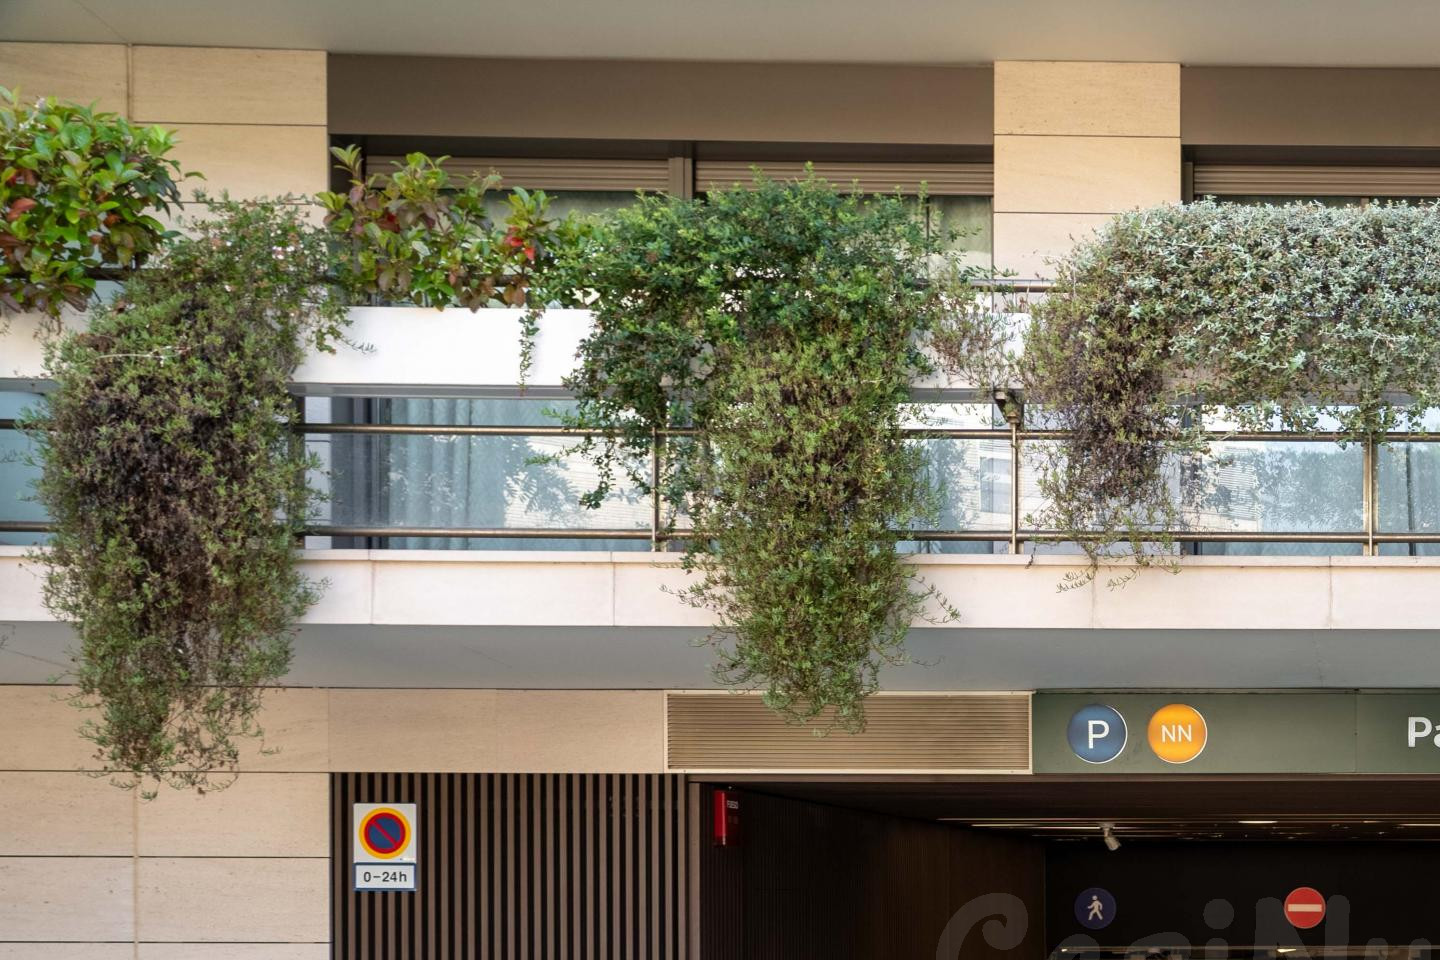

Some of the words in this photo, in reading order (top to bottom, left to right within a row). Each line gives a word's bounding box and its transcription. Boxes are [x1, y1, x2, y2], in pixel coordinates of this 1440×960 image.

[1087, 719, 1110, 750] P
[1161, 724, 1193, 743] NN
[363, 871, 407, 883] 0-24h
